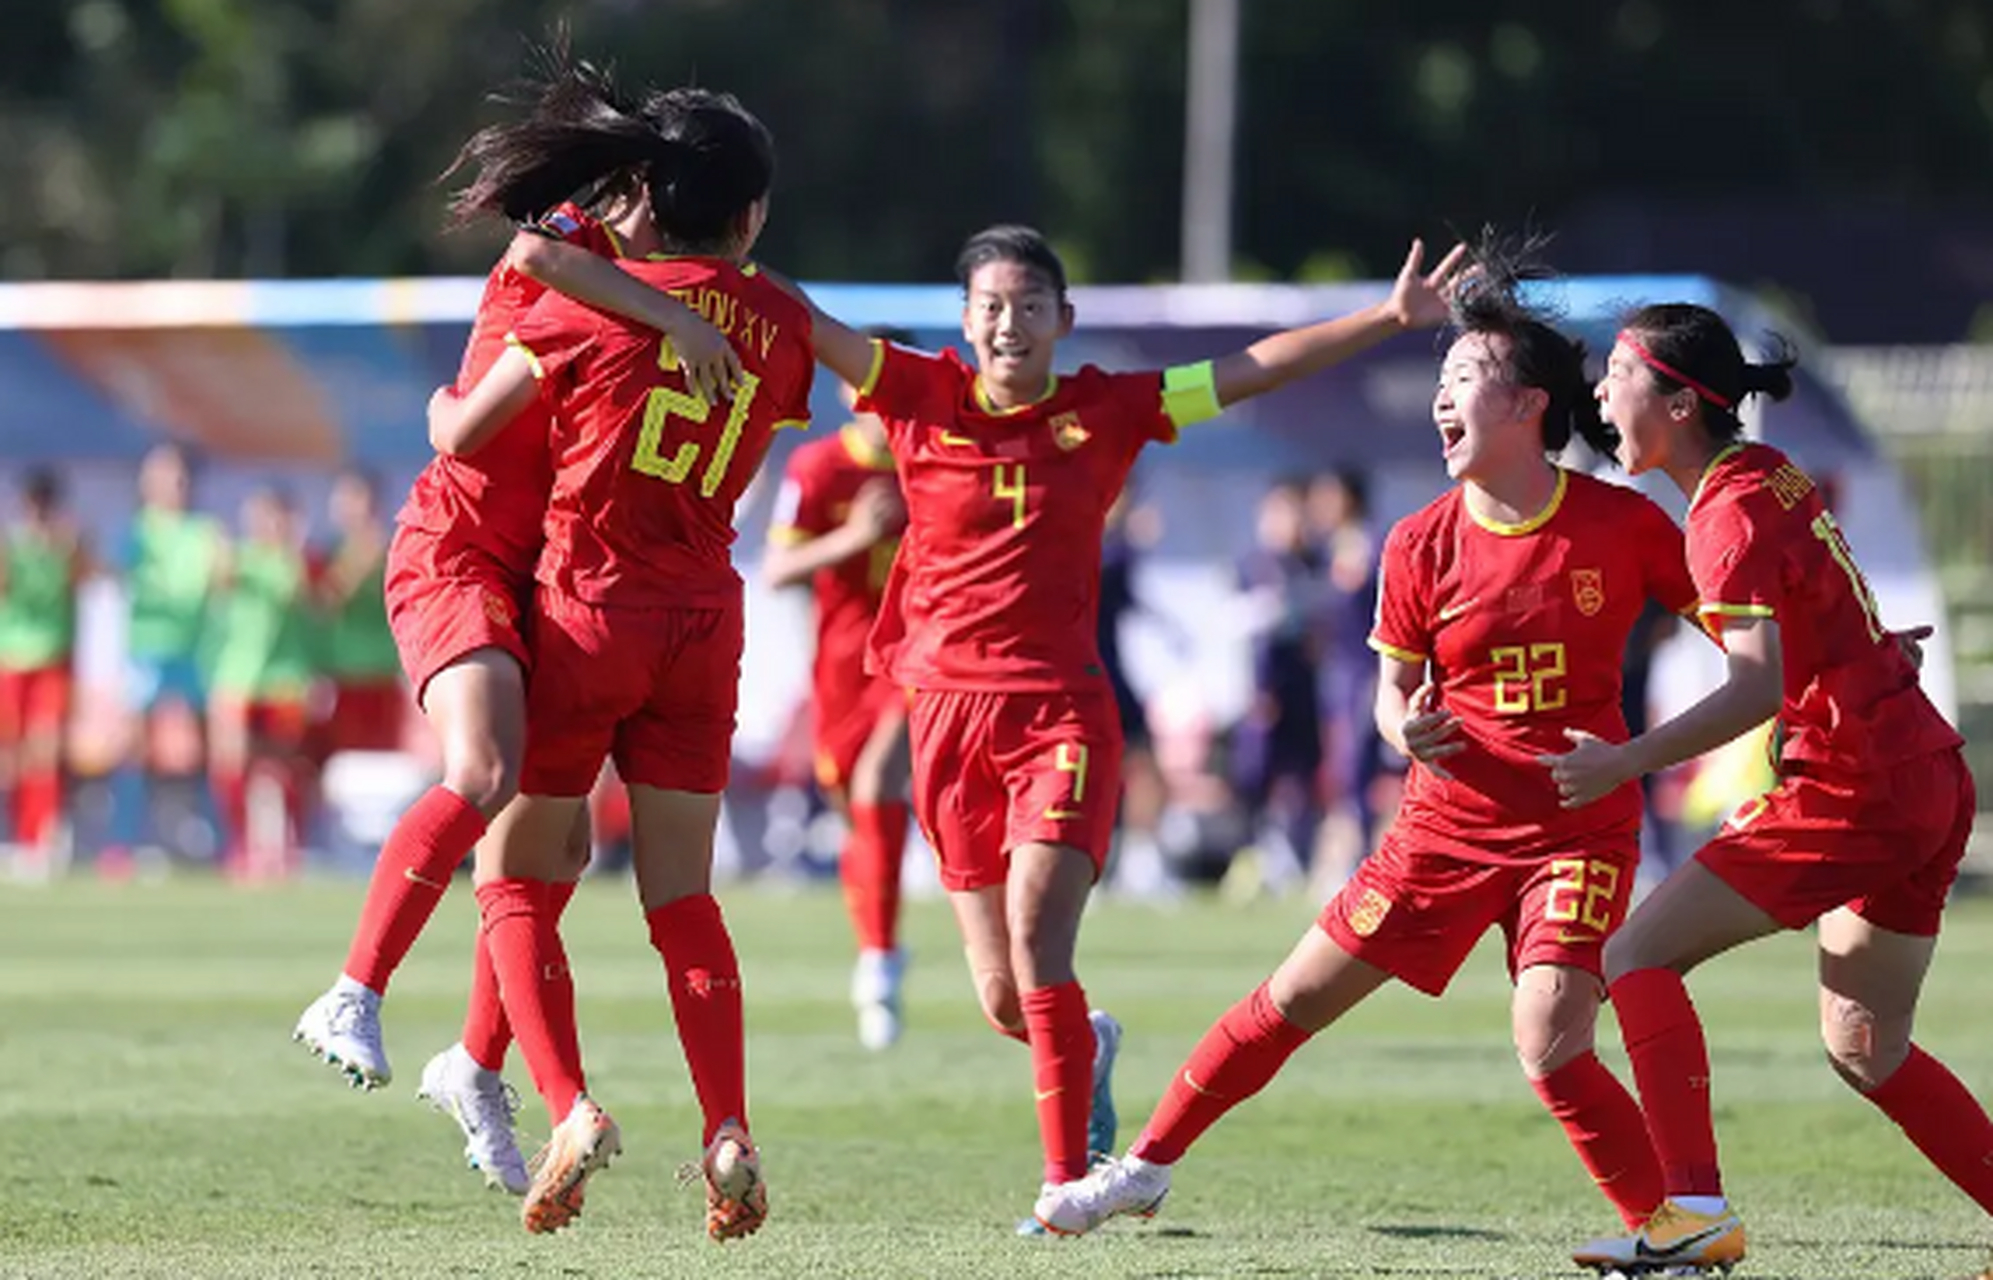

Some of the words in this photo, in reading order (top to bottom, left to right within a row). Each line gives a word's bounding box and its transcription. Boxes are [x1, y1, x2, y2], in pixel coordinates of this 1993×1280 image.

[631, 332, 761, 498] 21
[992, 463, 1026, 530] 4
[1489, 642, 1567, 714] 22
[1056, 742, 1088, 803] 4
[1544, 858, 1619, 934] 22
